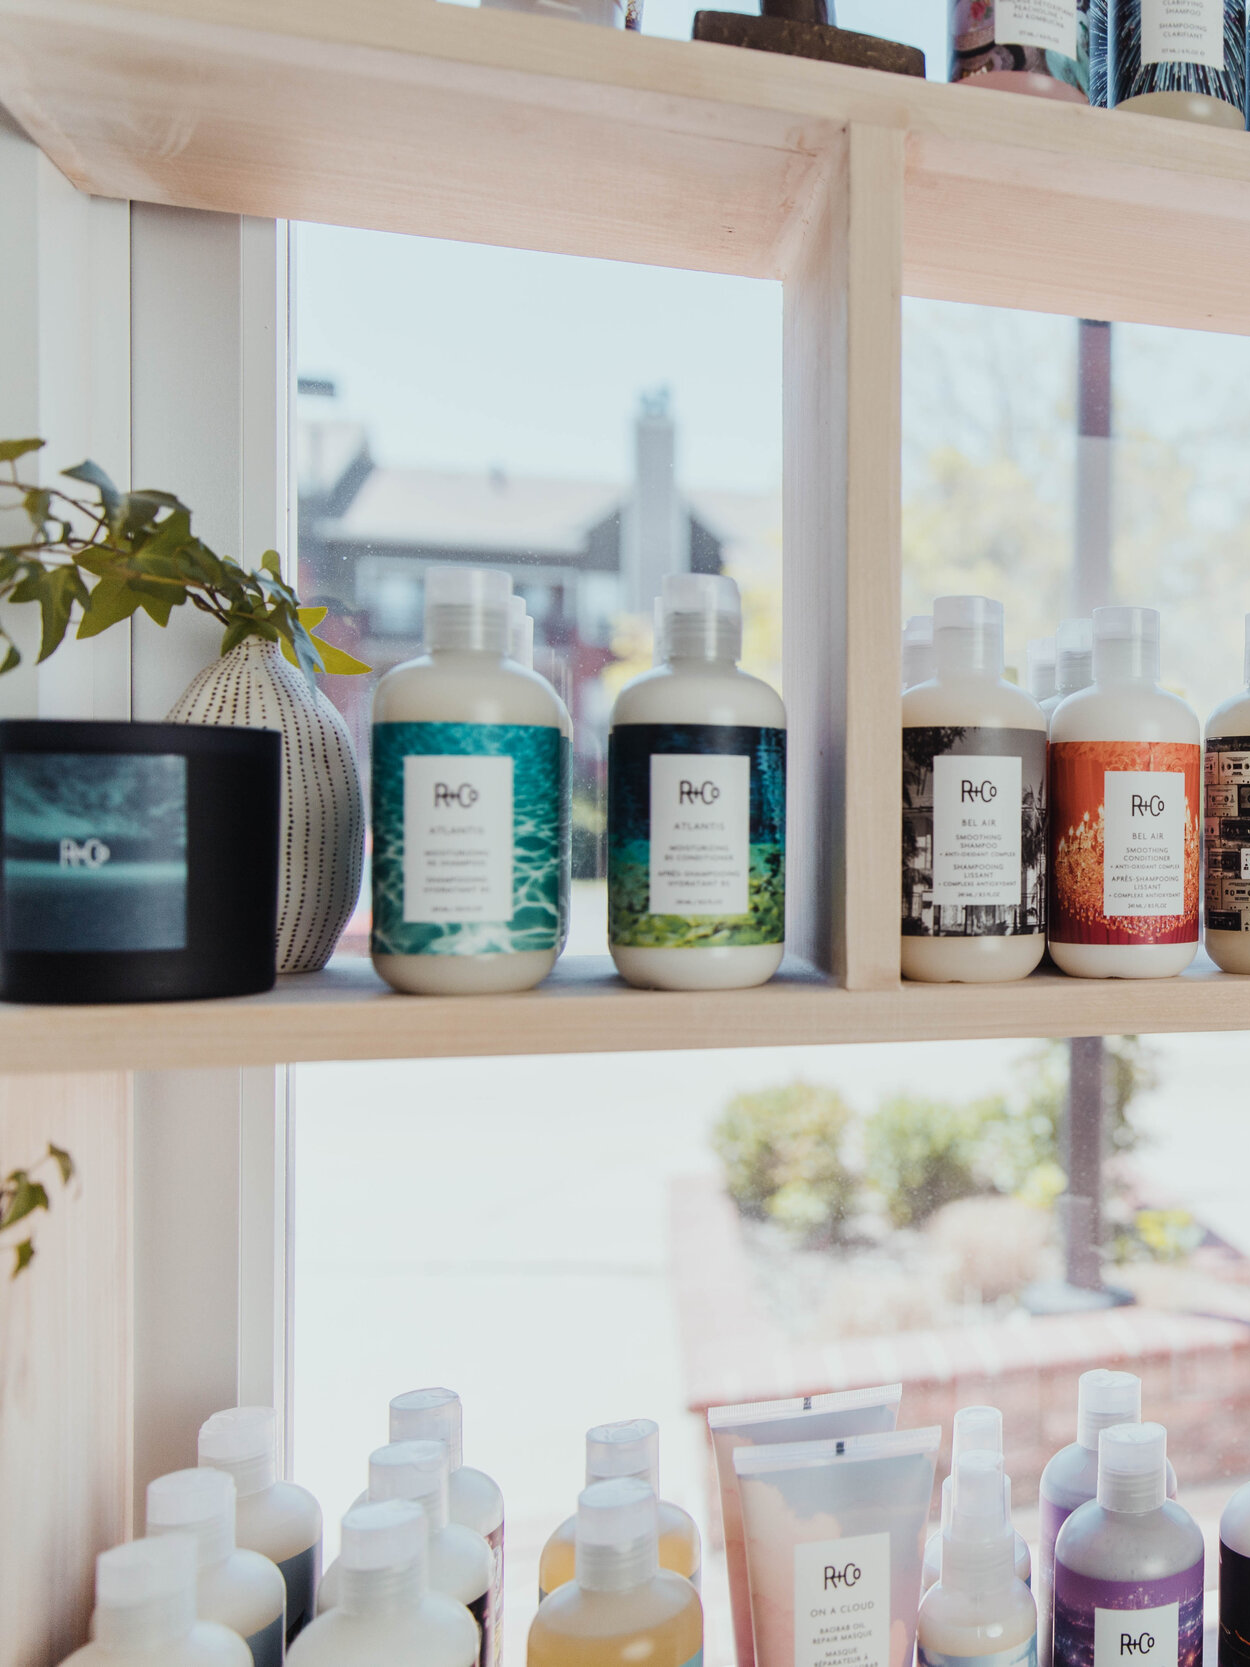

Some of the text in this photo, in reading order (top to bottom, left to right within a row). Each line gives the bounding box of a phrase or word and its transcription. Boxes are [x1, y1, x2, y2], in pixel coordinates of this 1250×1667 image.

[1165, 8, 1201, 16] SHAMPOO
[1159, 23, 1207, 32] SHAMPOOING
[961, 780, 998, 803] R+Co
[1132, 794, 1165, 817] R+Co
[961, 818, 996, 827] BEL AIR
[1132, 832, 1164, 840] BEL AIR
[824, 1563, 861, 1590] R+Co
[810, 1601, 875, 1618] ON A CLOUD
[1120, 1632, 1155, 1655] R+Co
